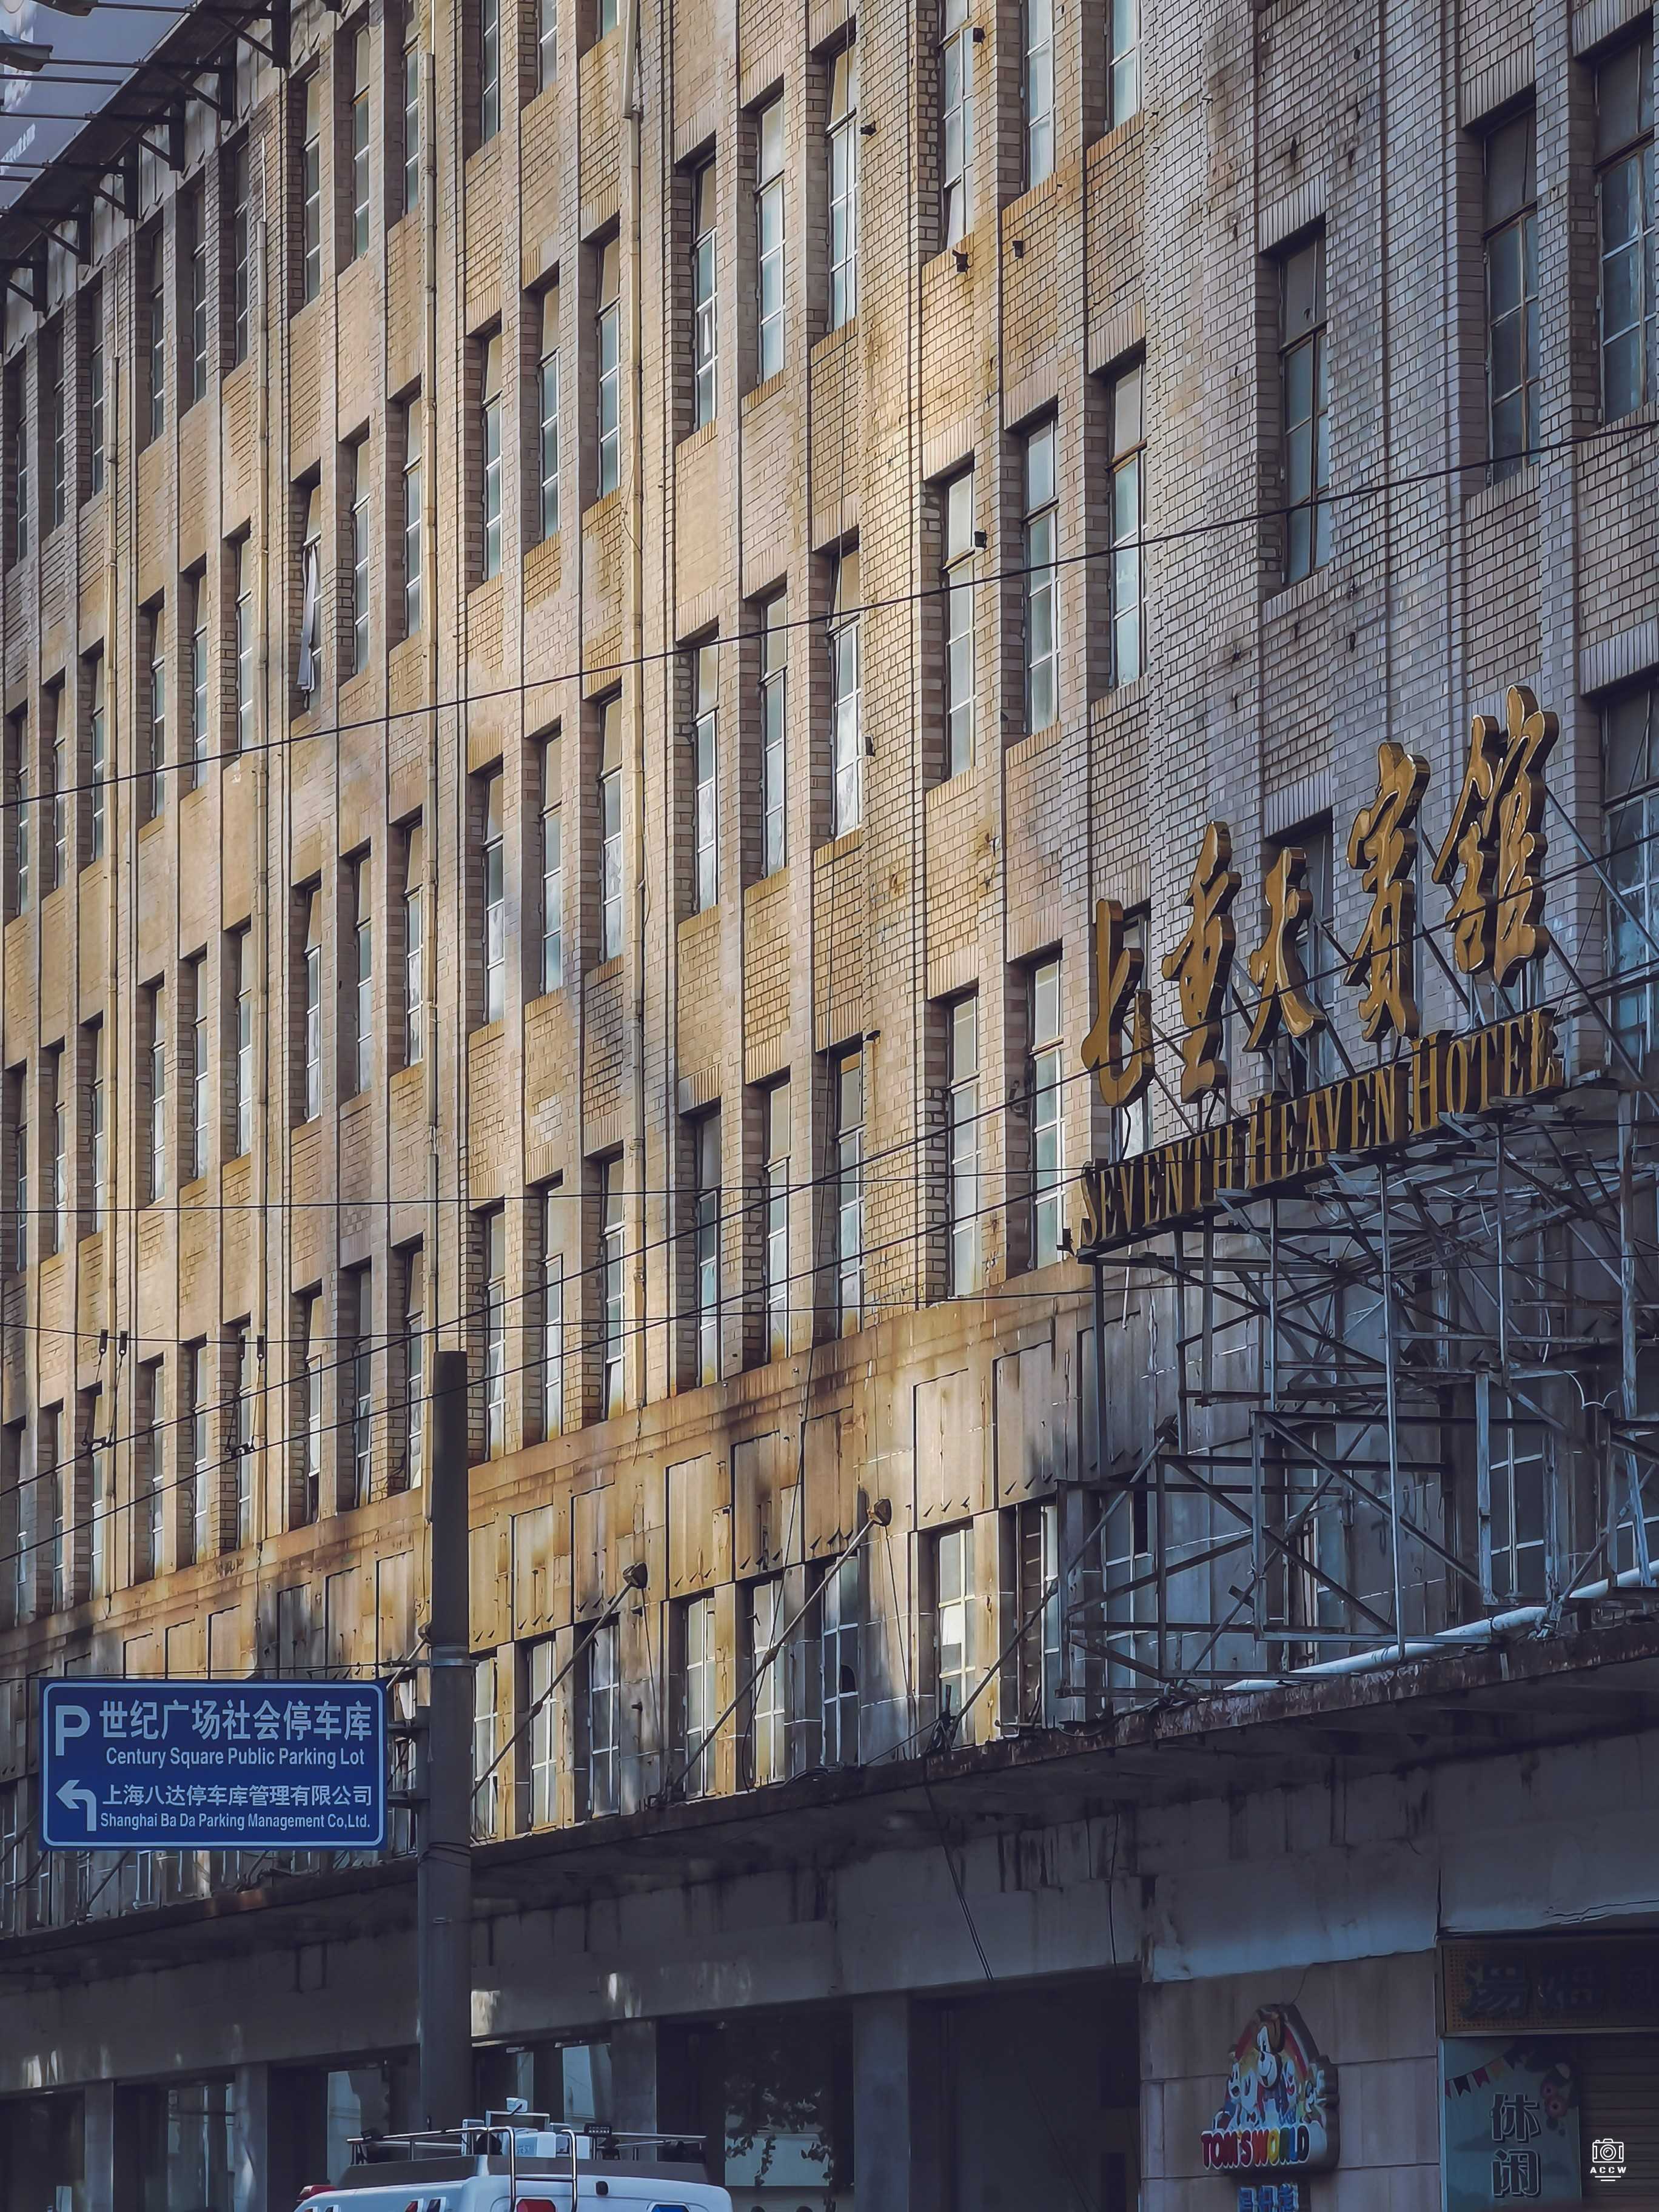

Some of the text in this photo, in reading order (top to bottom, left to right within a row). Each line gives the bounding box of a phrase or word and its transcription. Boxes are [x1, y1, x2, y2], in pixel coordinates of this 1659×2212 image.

[1081, 1008, 1564, 1245] SEVENTH HEAVEN HOTEL
[55, 1705, 90, 1756] P
[99, 1699, 372, 1741] 世纪广场社会停车库
[106, 1747, 364, 1769] Century Square Public Parking Lot
[102, 1785, 372, 1806] 上海八达停车库管理有限公司
[100, 1812, 370, 1831] Shanghai Ba Da Parking Management Co,Ltd.
[1200, 2123, 1310, 2170] TOM'S WORLD
